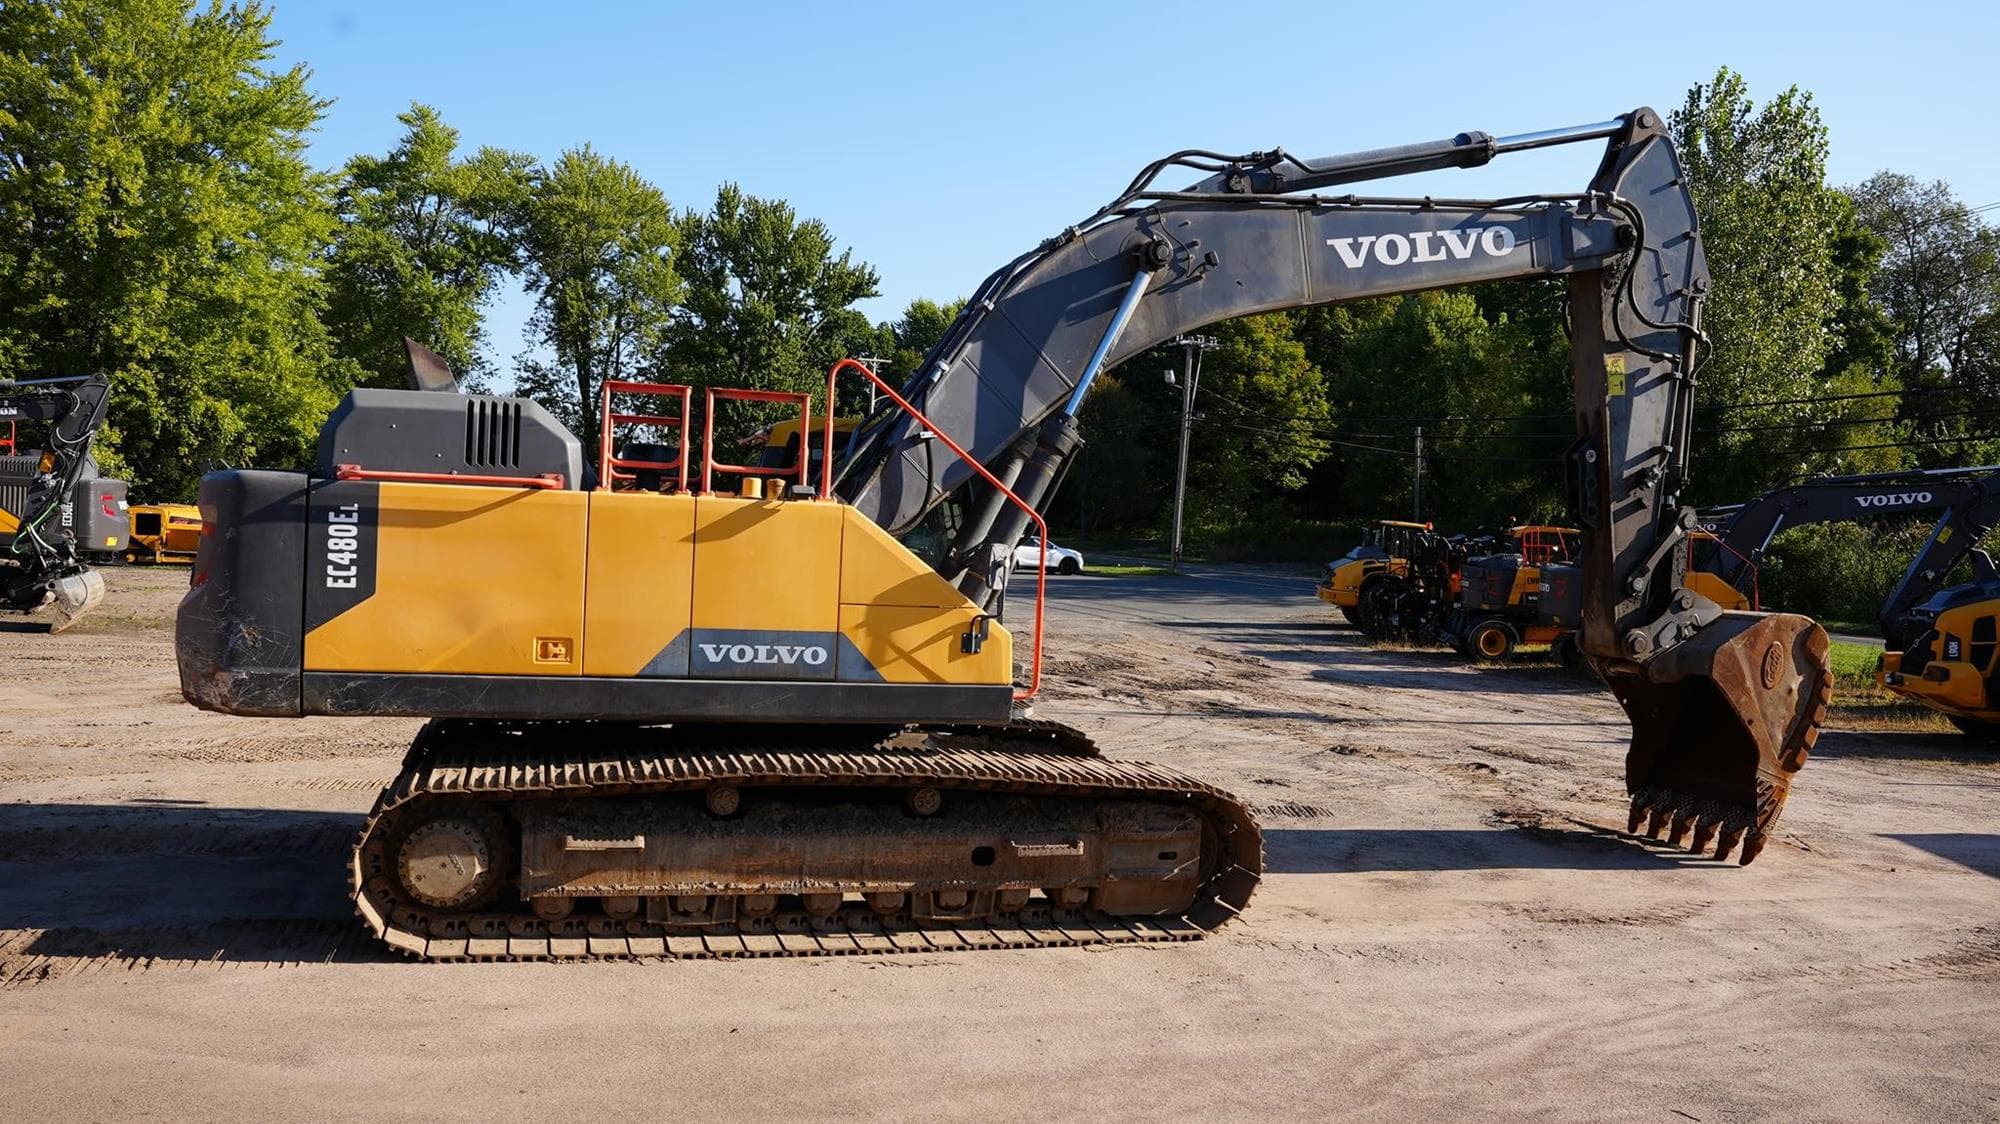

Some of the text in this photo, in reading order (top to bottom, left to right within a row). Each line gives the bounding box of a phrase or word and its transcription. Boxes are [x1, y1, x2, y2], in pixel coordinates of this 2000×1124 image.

[1326, 225, 1516, 269] VOLVO
[1854, 491, 1933, 507] VOLVO
[699, 644, 828, 665] VOLVO
